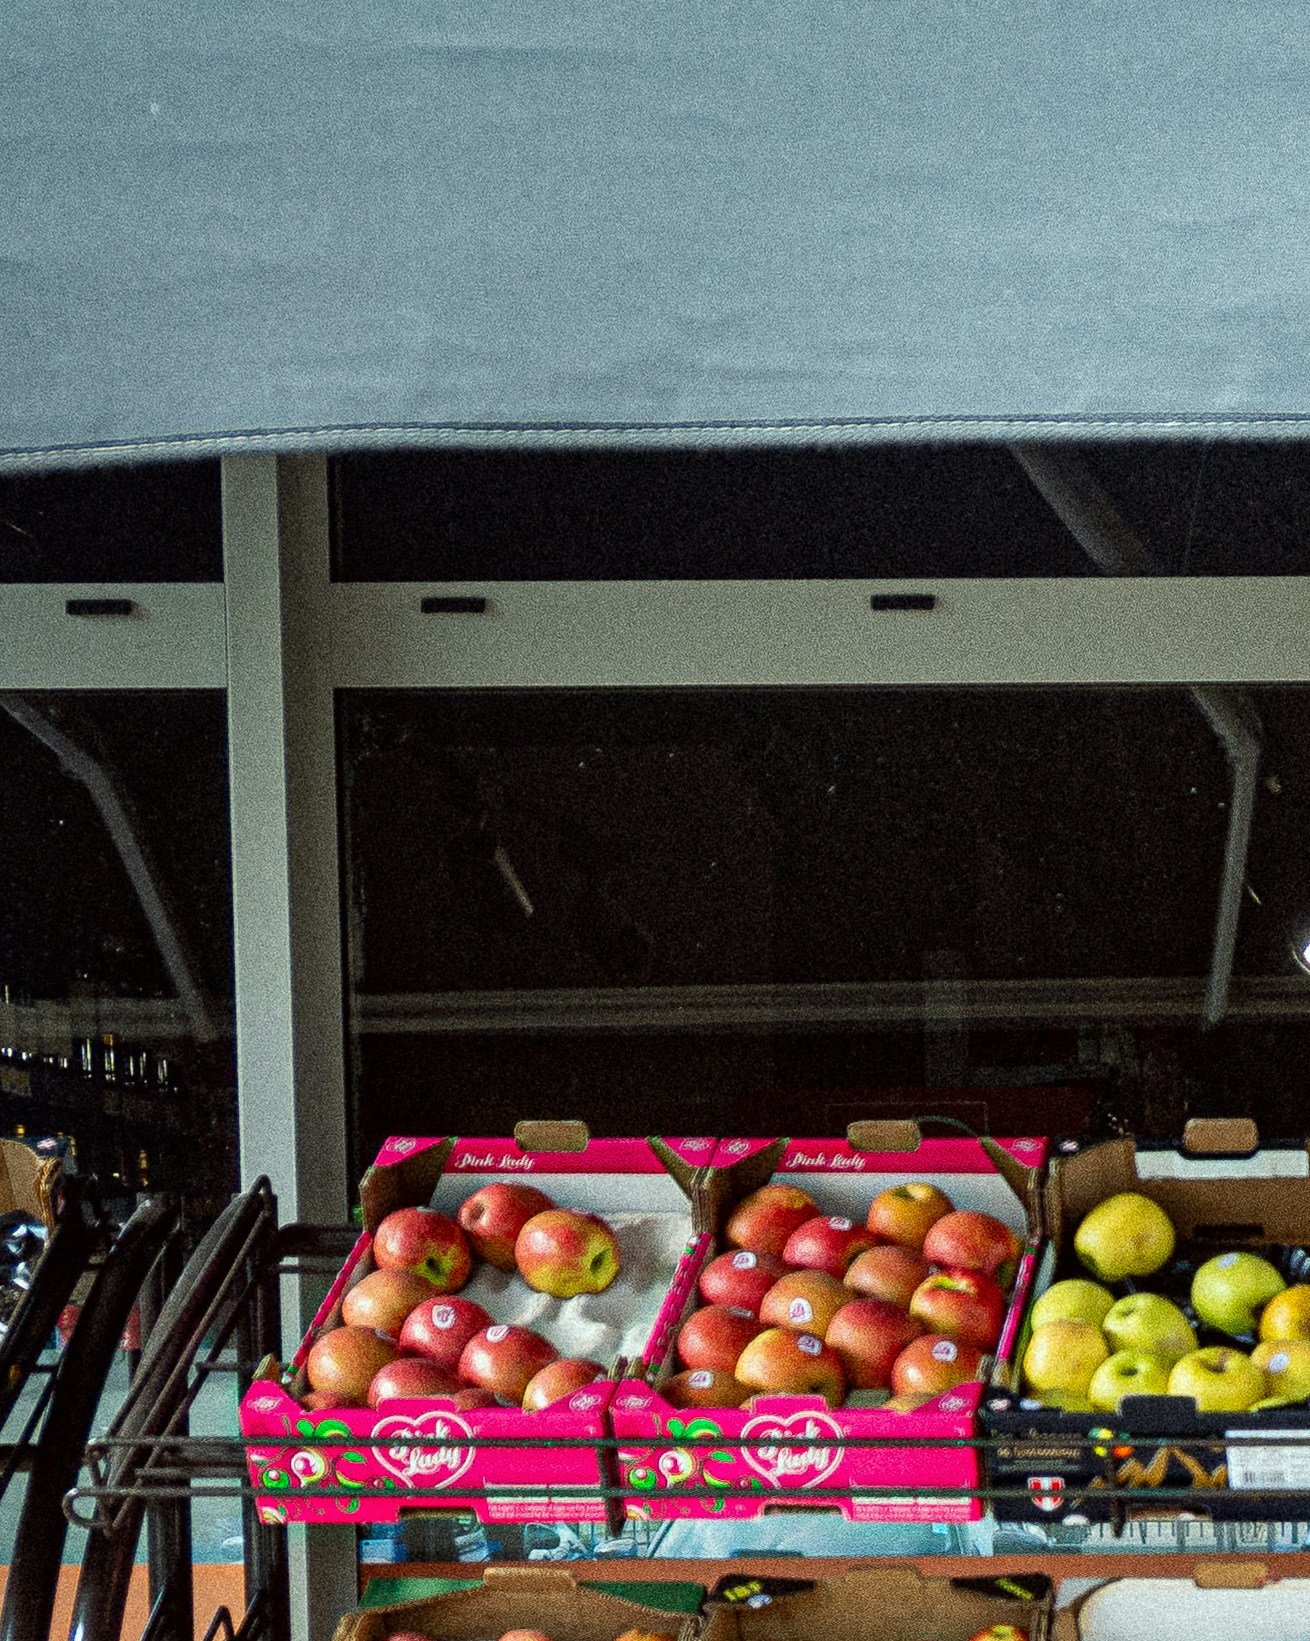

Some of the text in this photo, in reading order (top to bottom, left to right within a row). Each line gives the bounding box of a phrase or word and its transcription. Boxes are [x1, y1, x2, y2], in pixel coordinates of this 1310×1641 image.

[455, 1152, 534, 1171] Pink Lady
[785, 1152, 867, 1171] Pink Lady
[403, 1445, 461, 1477] Lady
[773, 1445, 831, 1477] Lady
